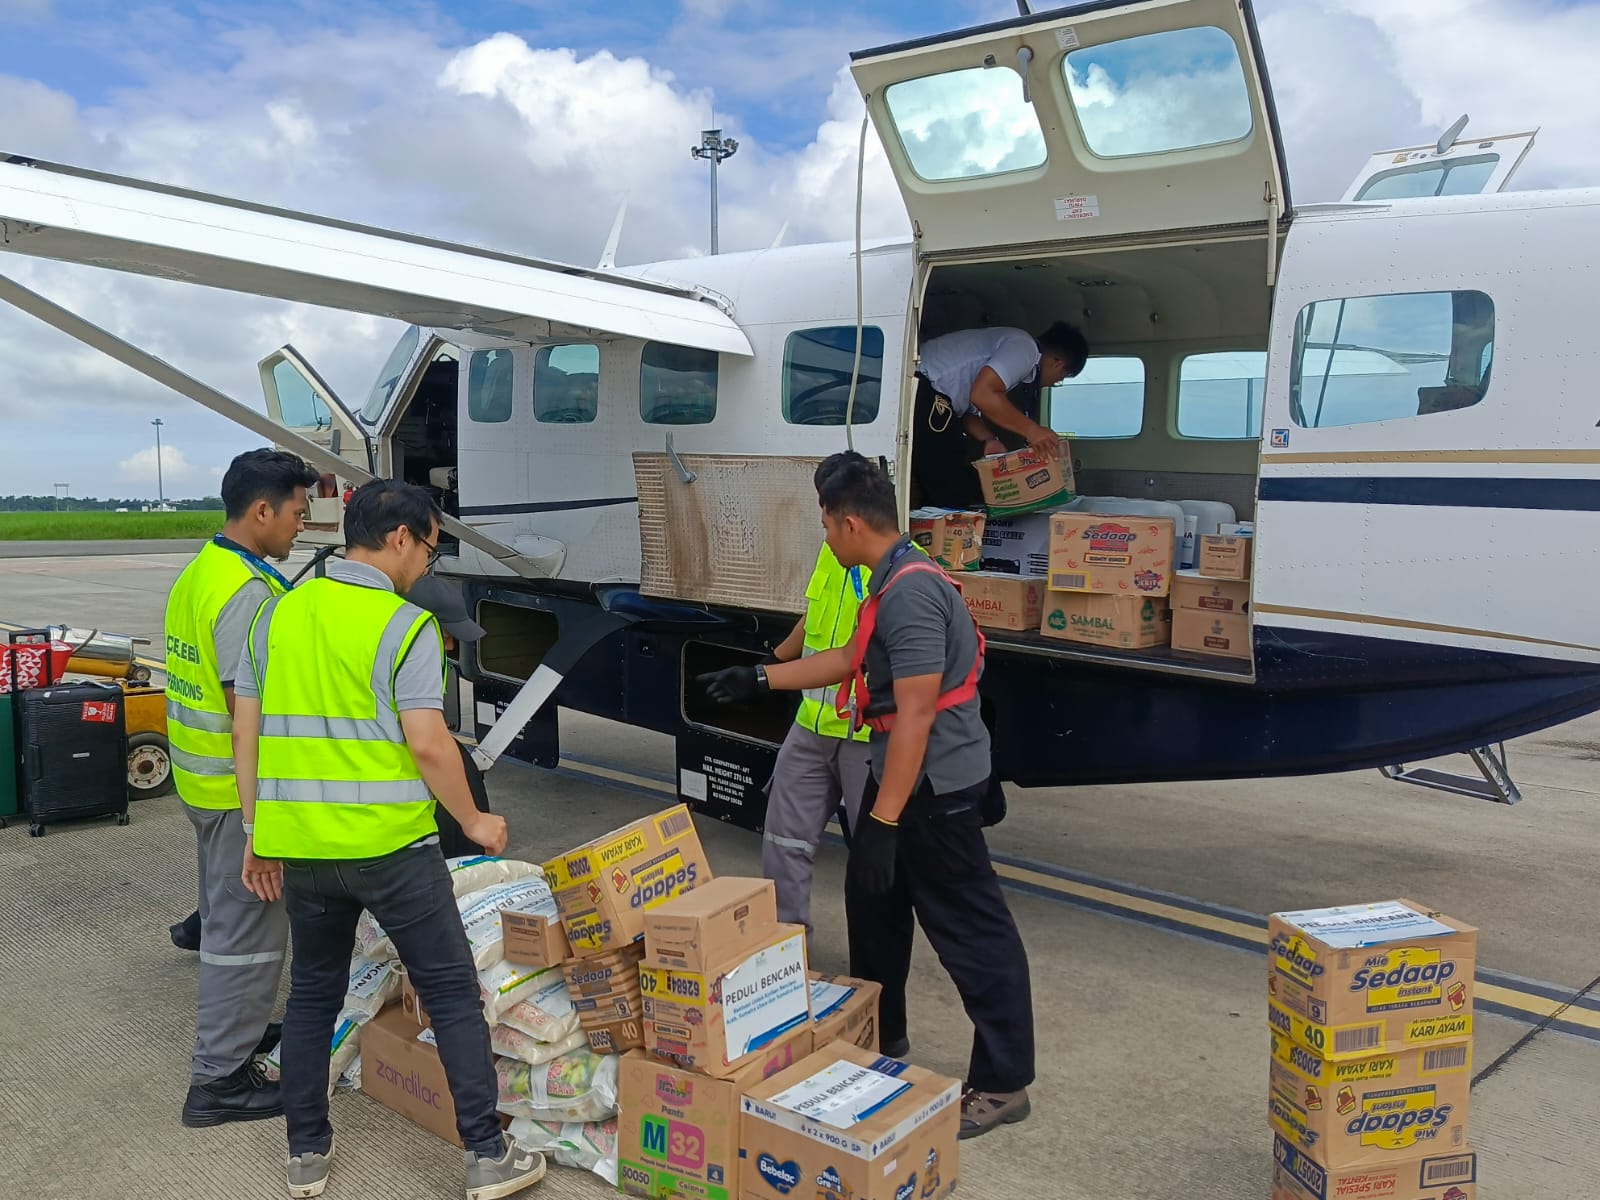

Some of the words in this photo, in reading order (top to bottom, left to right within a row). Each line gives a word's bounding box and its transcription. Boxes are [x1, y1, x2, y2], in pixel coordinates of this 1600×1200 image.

[1081, 529, 1137, 542] Sedaap
[964, 597, 1005, 612] SAMBAL
[1070, 614, 1115, 630] SAMBAL
[622, 834, 642, 851] KARI
[601, 843, 624, 862] AYAM
[630, 862, 697, 909] Sedaap
[567, 919, 612, 943] Sedaap
[1270, 938, 1325, 978] Sedaap
[1364, 955, 1389, 967] Mie
[571, 968, 612, 985] Sedaap
[641, 973, 657, 993] 40
[725, 983, 758, 1006] PEDULI
[761, 961, 802, 990] BENCANA
[1349, 960, 1456, 992] Sedaap
[670, 976, 700, 997] 62684
[1397, 984, 1434, 998] Instant
[619, 1003, 627, 1014] 9
[1311, 1004, 1321, 1018] 9
[622, 1022, 638, 1039] 40
[1304, 1025, 1325, 1049] 40
[1410, 1025, 1435, 1039] KARI
[1437, 1020, 1466, 1035] AYAM
[1336, 1062, 1368, 1077] AYAM
[1368, 1058, 1394, 1072] KARI
[375, 1058, 441, 1110] zandilac
[826, 1069, 871, 1096] BENCANA
[661, 1105, 685, 1119] Pants
[754, 1106, 776, 1121] BARU!
[1372, 1099, 1406, 1113] Instant
[1346, 1104, 1453, 1135] Sedaap
[642, 1121, 666, 1153] M
[671, 1131, 700, 1162] 32
[825, 1133, 840, 1145] 900
[1415, 1128, 1438, 1139] Mie
[1275, 1139, 1287, 1163] 40
[622, 1166, 650, 1185] 50050
[711, 1169, 720, 1180] 4
[760, 1160, 795, 1184] Bebelac
[1338, 1174, 1368, 1186] KENTAL
[1335, 1182, 1372, 1195] SPESIAL
[1373, 1179, 1396, 1189] KARI
